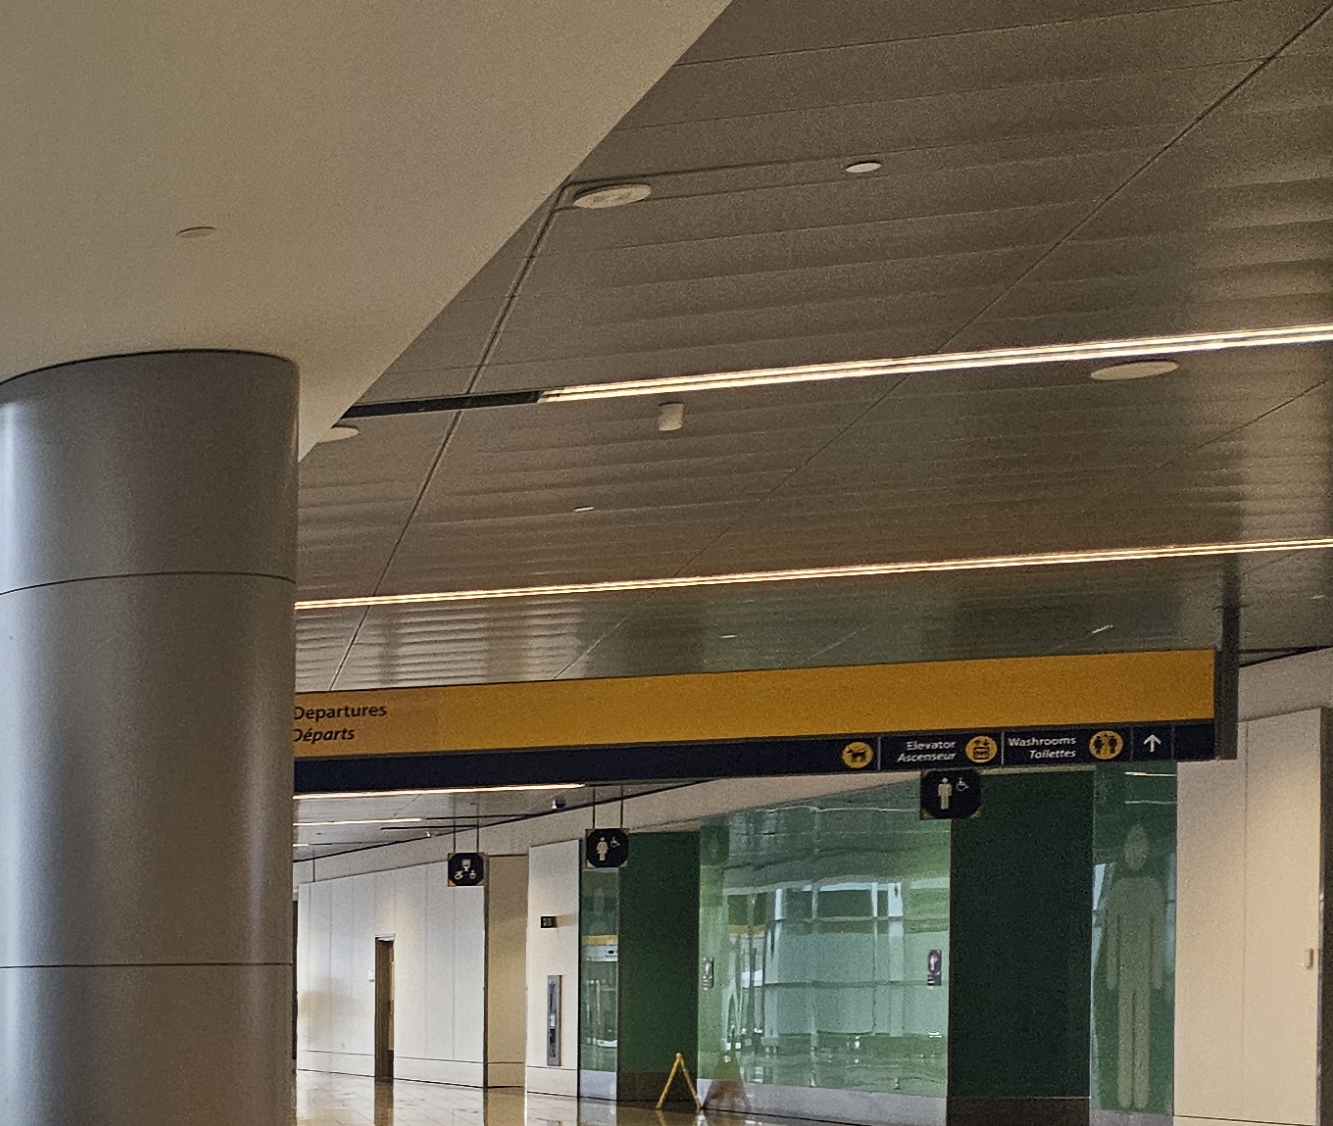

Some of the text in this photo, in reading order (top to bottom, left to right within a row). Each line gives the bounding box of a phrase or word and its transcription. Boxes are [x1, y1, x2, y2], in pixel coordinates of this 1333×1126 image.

[294, 705, 388, 722] Departures
[294, 728, 355, 745] Départs
[906, 741, 956, 751] Elevator
[1007, 737, 1077, 747] Washrooms
[897, 753, 957, 763] Ascenseur
[1029, 749, 1077, 759] Toilettes
